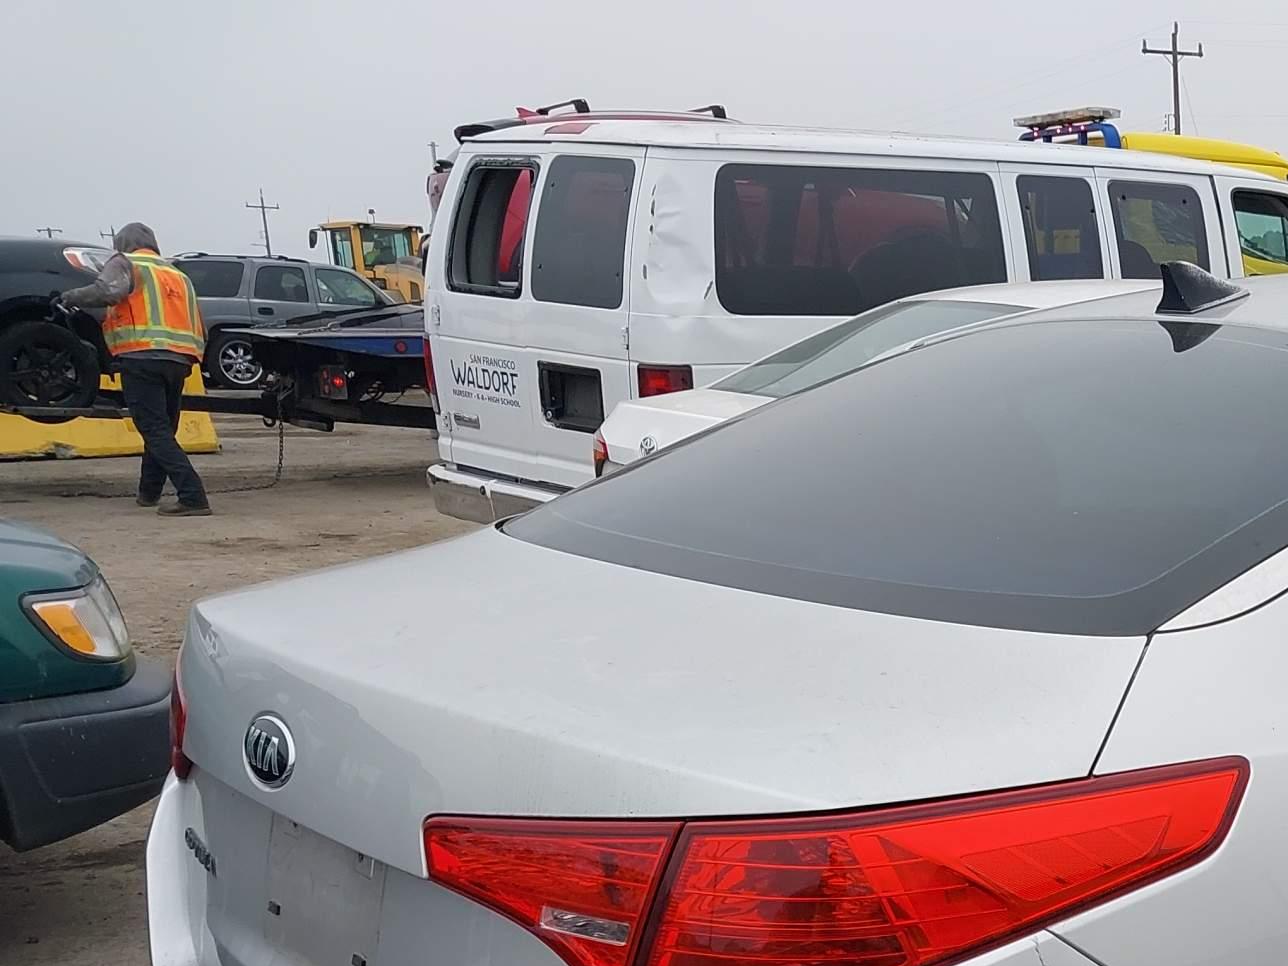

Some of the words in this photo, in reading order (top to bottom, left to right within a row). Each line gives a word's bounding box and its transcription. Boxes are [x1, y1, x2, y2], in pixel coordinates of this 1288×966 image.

[470, 354, 482, 365] SAN
[482, 356, 515, 370] FRANCISCO
[450, 359, 518, 397] WALDORF
[500, 397, 521, 408] SCHOOL
[246, 725, 280, 776] KIA
